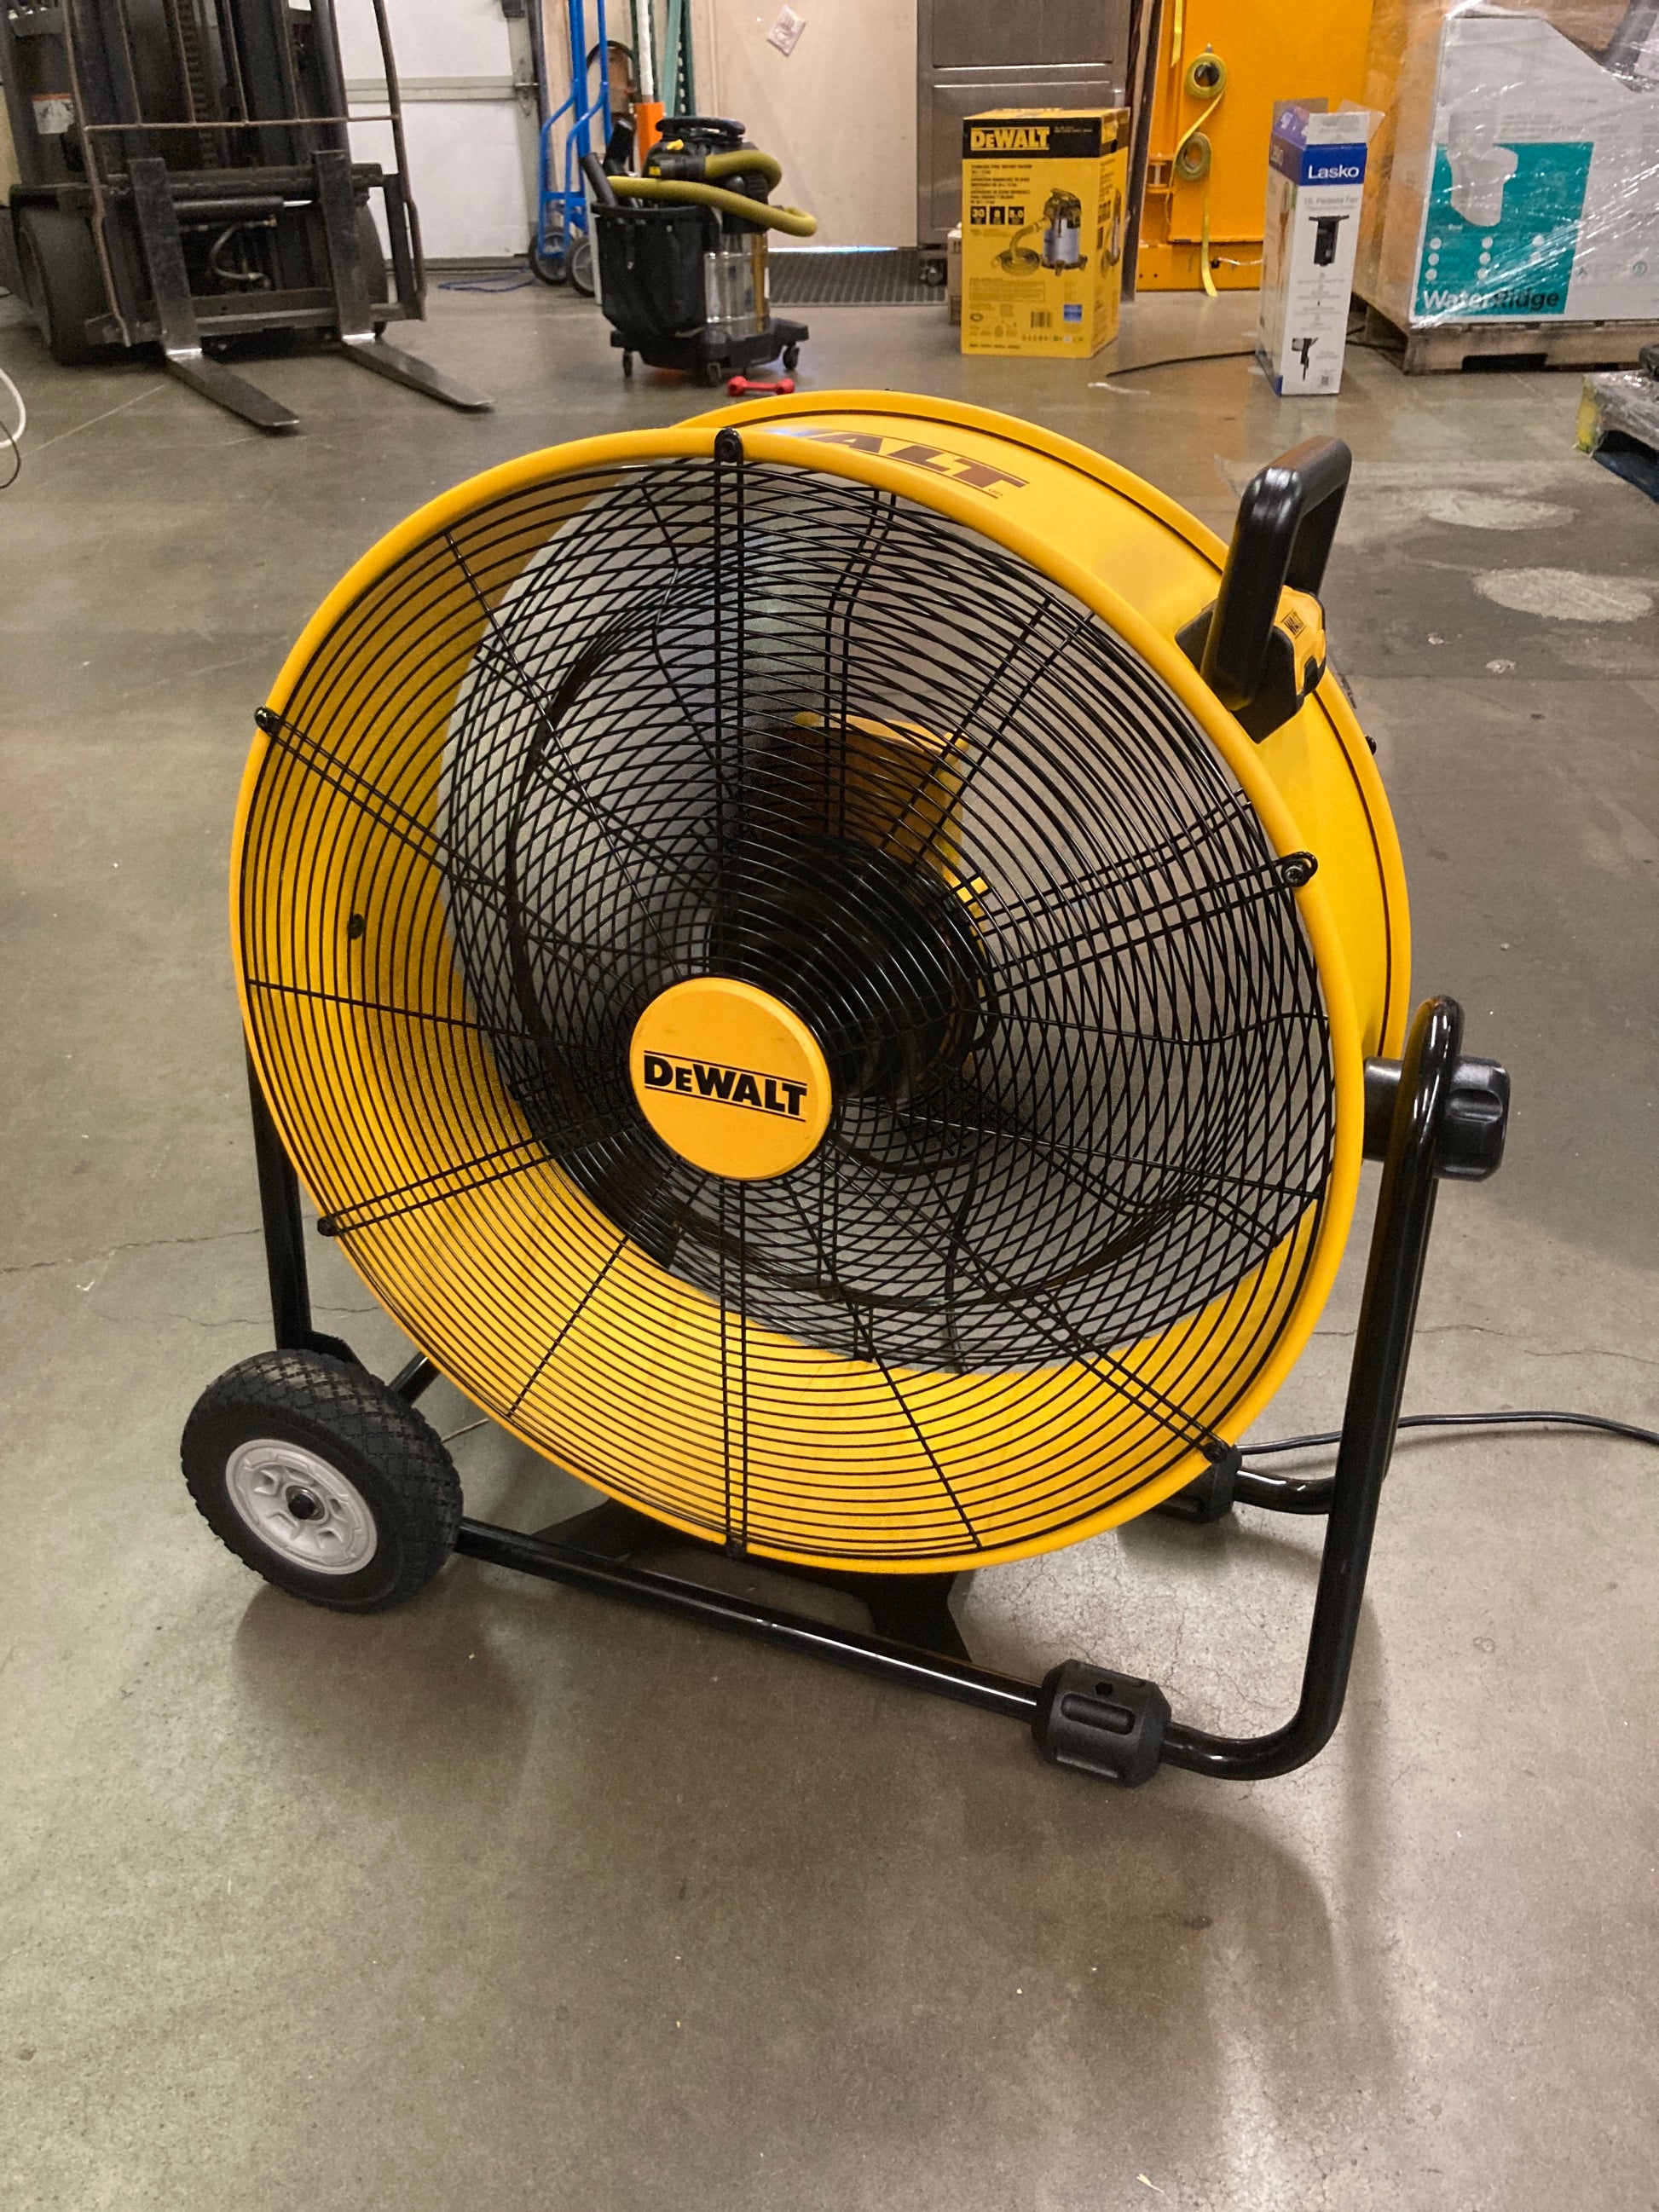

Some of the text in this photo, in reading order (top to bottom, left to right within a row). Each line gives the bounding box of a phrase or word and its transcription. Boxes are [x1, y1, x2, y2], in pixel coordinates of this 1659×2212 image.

[1308, 165, 1360, 179] Lasko
[1423, 288, 1559, 310] WaterRidge
[791, 429, 1026, 488] ALT
